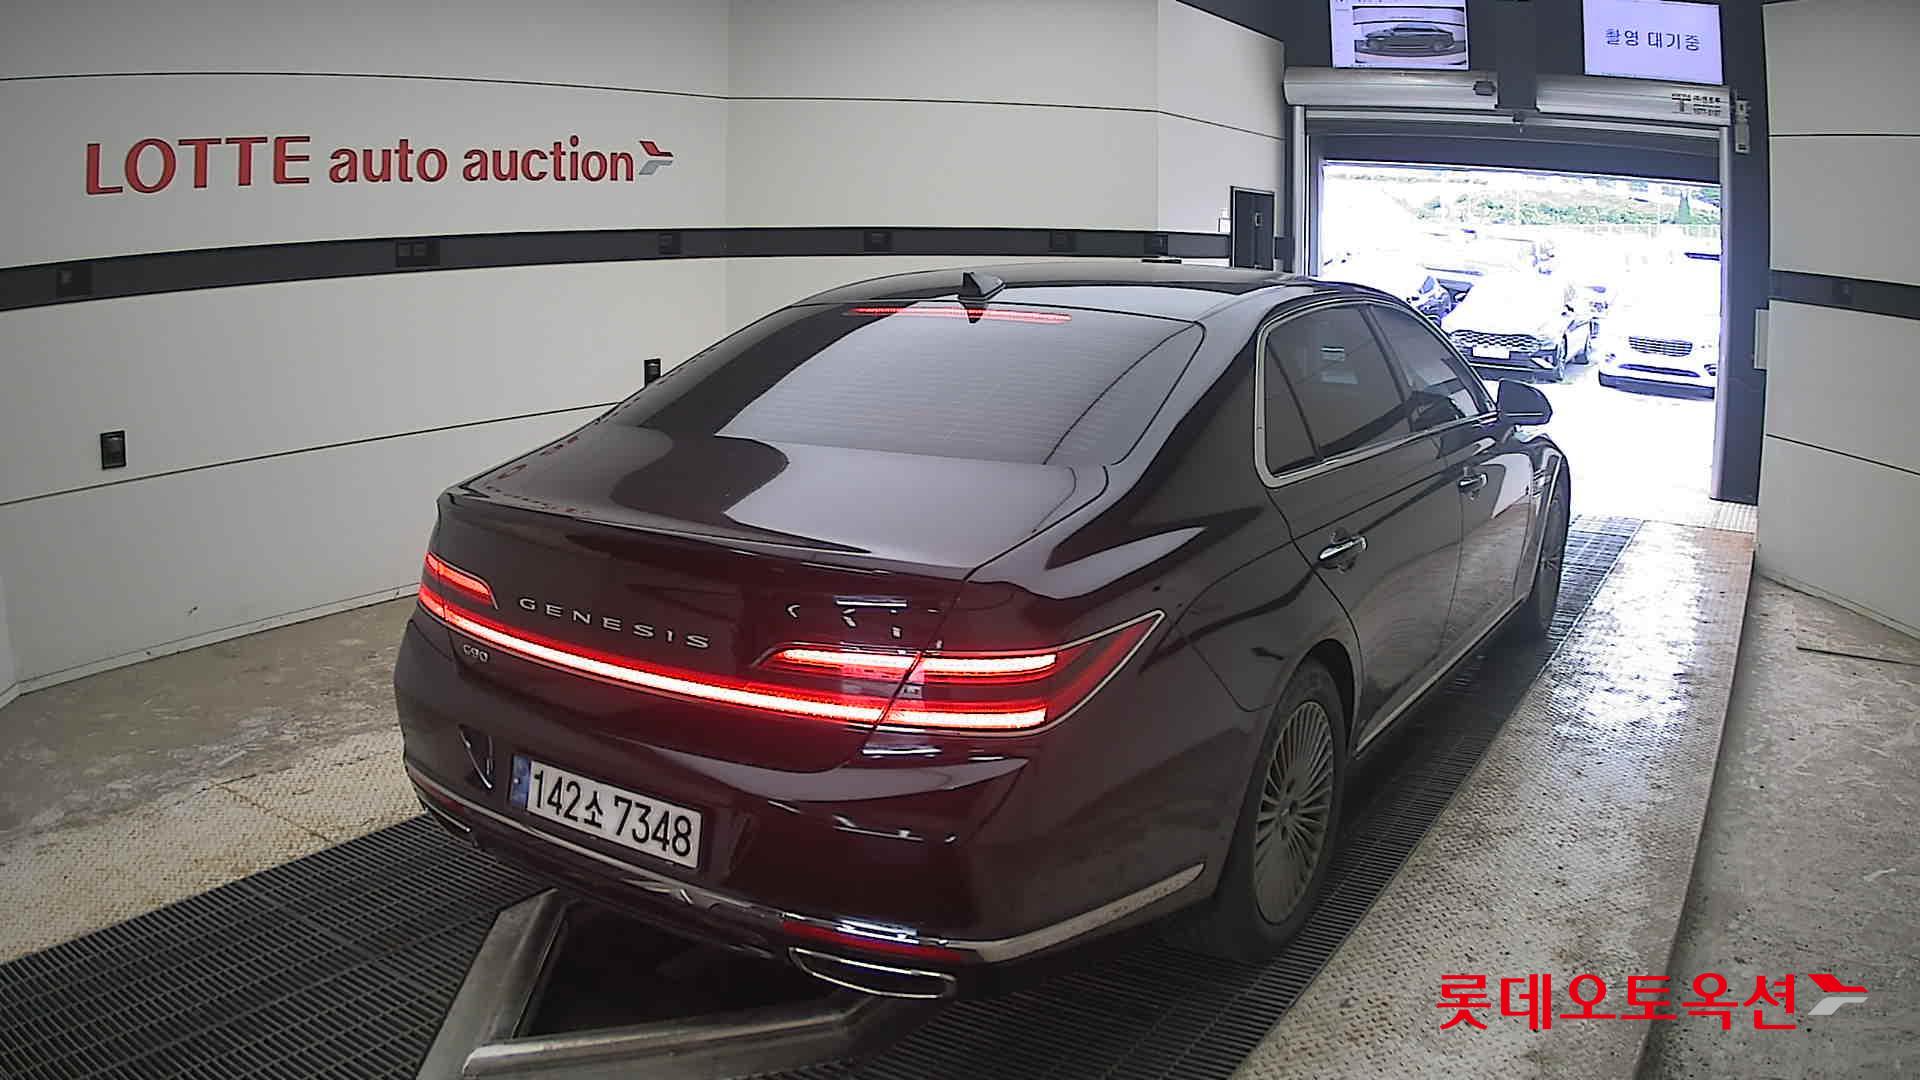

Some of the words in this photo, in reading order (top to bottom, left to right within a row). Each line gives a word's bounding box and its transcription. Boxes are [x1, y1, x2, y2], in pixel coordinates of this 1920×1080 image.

[1605, 27, 1640, 49] 촬영
[1647, 29, 1701, 52] 대기중
[85, 135, 311, 195] LOTTE
[328, 138, 448, 184] auto
[461, 135, 635, 183] auction
[519, 598, 711, 649] GENESIS
